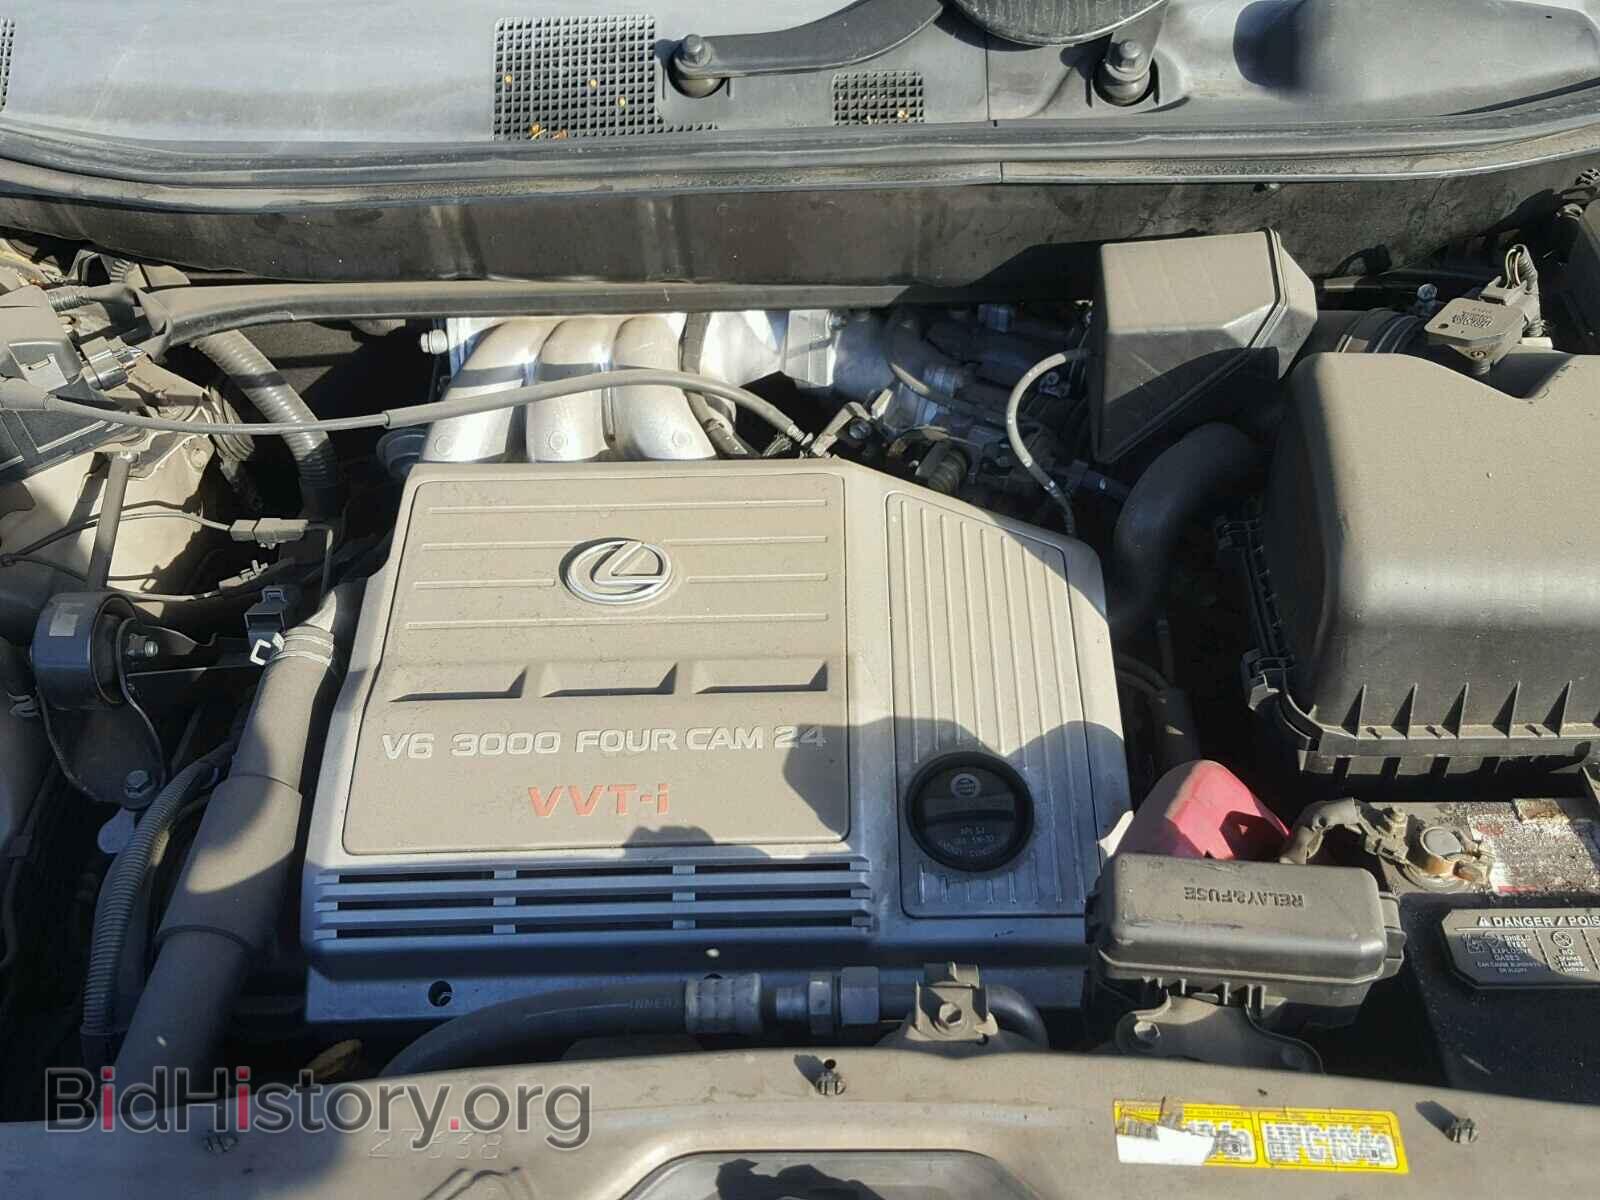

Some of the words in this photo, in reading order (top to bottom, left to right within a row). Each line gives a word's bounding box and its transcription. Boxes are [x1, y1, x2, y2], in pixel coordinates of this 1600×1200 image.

[381, 733, 435, 760] V6
[451, 731, 561, 756] 3000
[575, 729, 678, 753] FOUR
[686, 727, 763, 750] CAM
[773, 726, 827, 750] 24
[527, 783, 670, 817] VVT-i
[1492, 916, 1554, 927] DANGER
